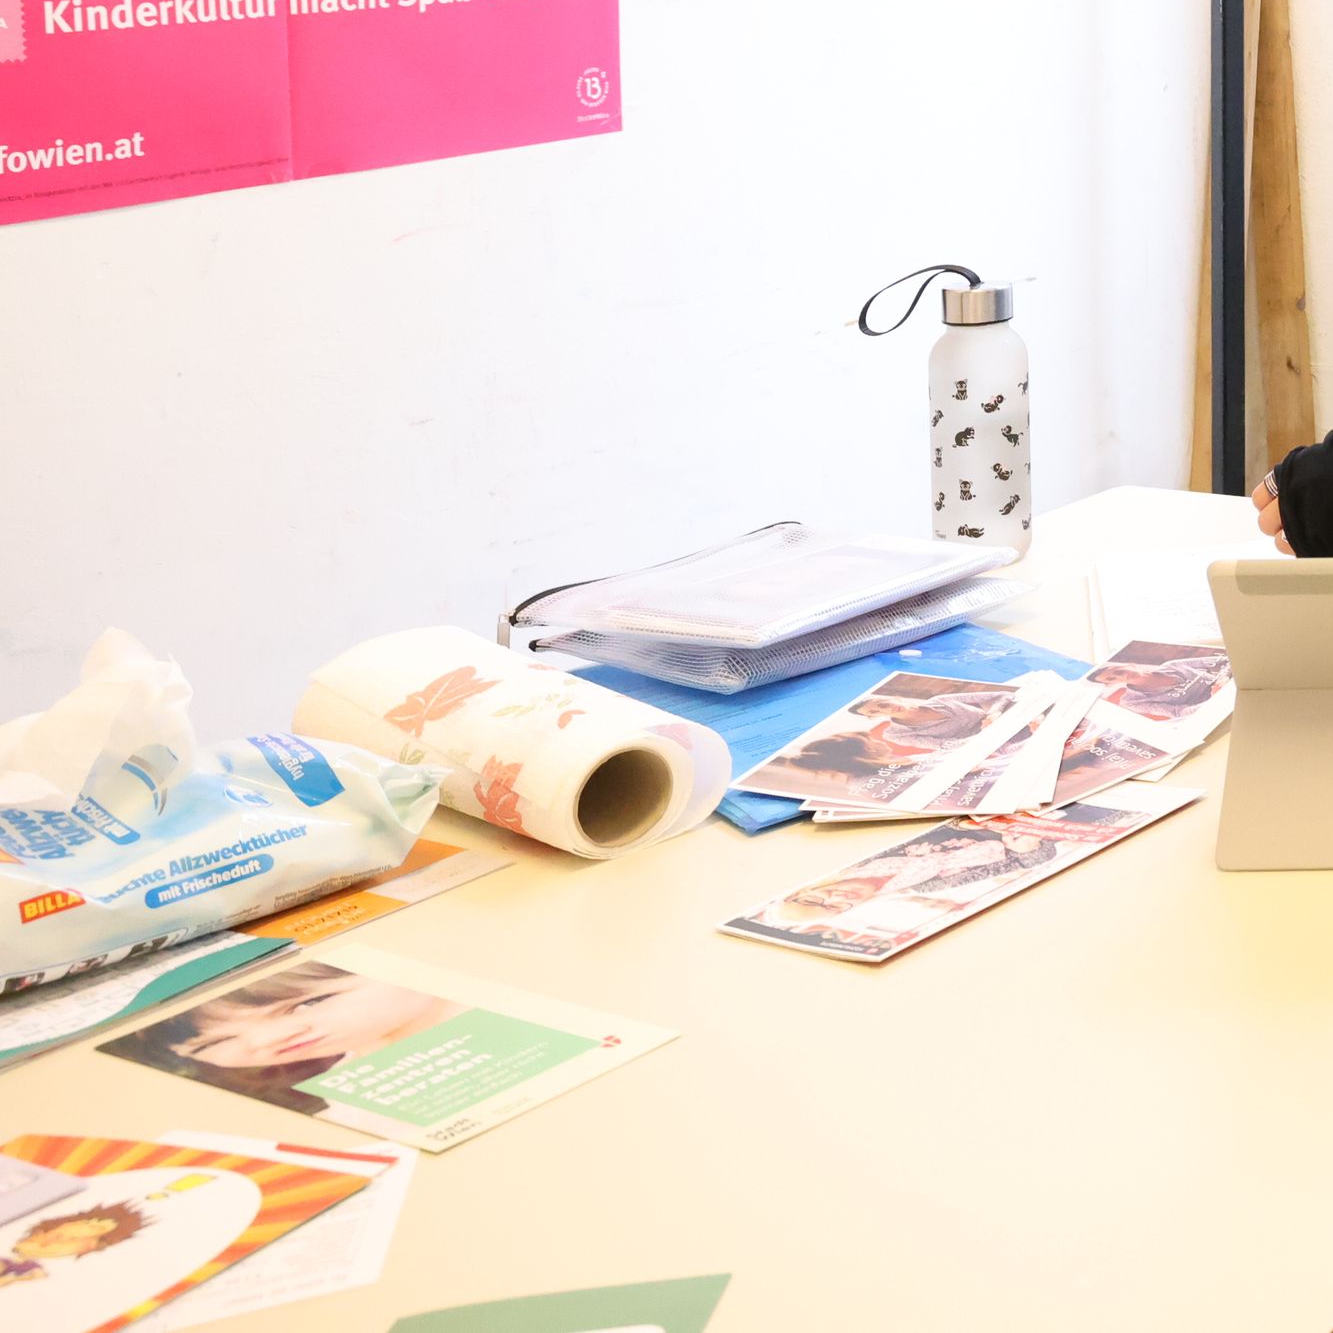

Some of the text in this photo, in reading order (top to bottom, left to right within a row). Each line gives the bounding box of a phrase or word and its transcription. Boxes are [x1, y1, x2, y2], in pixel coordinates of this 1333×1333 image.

[168, 824, 308, 877] Allzwecktücher
[157, 889, 182, 902] mit
[182, 859, 262, 894] Frischeduft
[24, 893, 81, 920] BILLA
